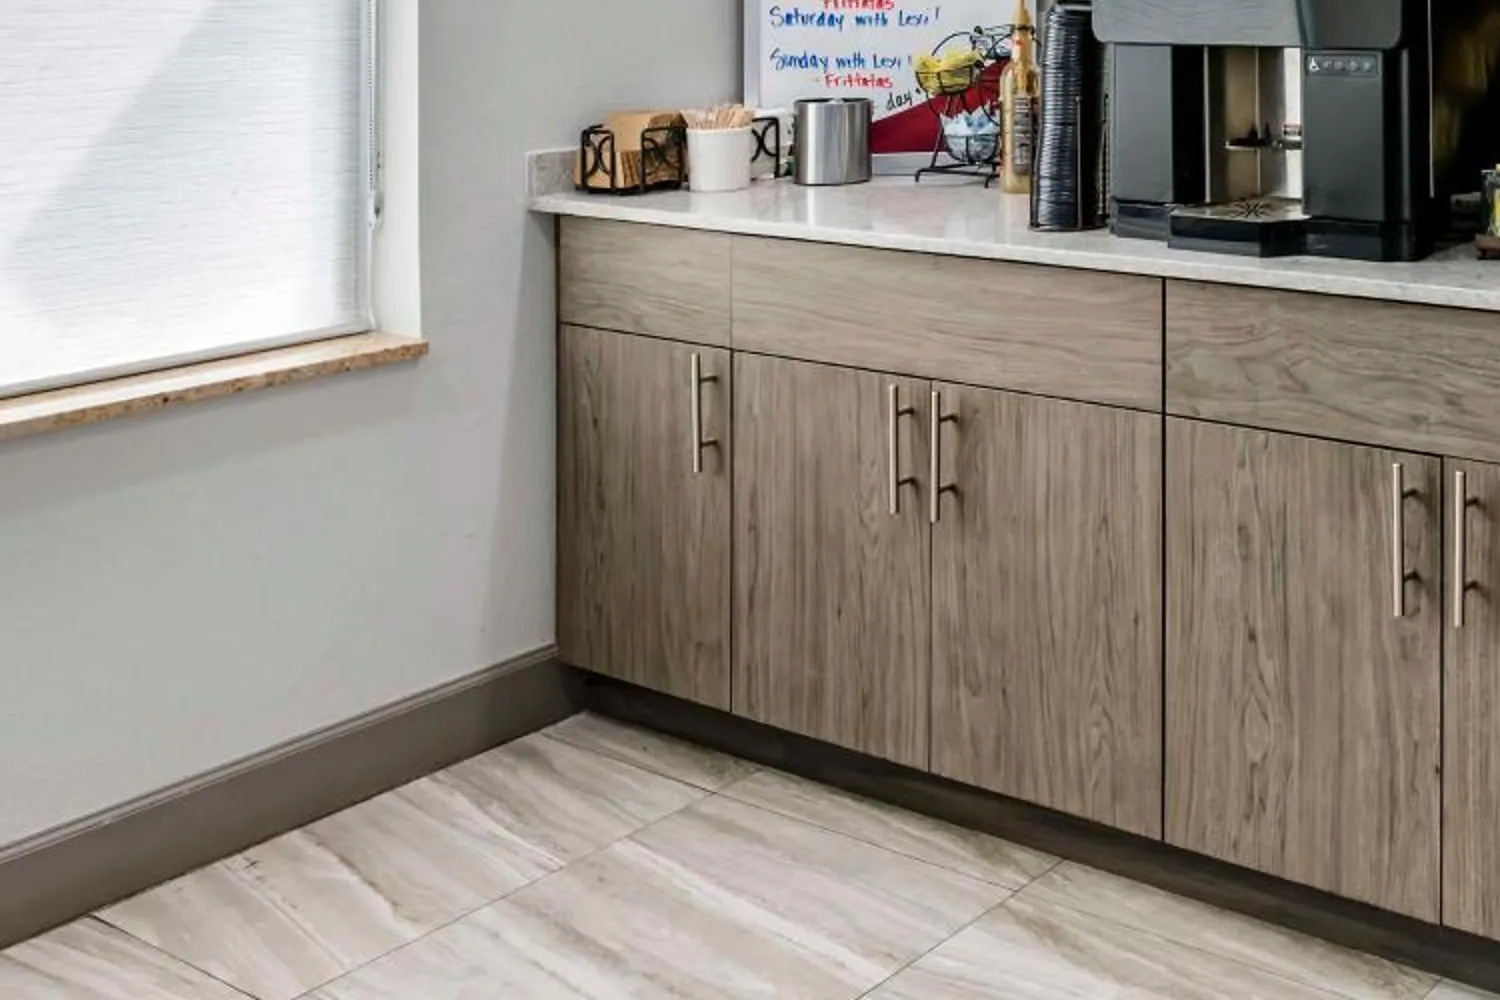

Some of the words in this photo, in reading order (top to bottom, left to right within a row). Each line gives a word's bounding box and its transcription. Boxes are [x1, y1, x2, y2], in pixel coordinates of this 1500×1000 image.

[769, 6, 846, 32] Saturday
[855, 13, 889, 28] with
[770, 48, 829, 74] Sunday
[836, 52, 866, 71] with
[886, 89, 914, 111] day
